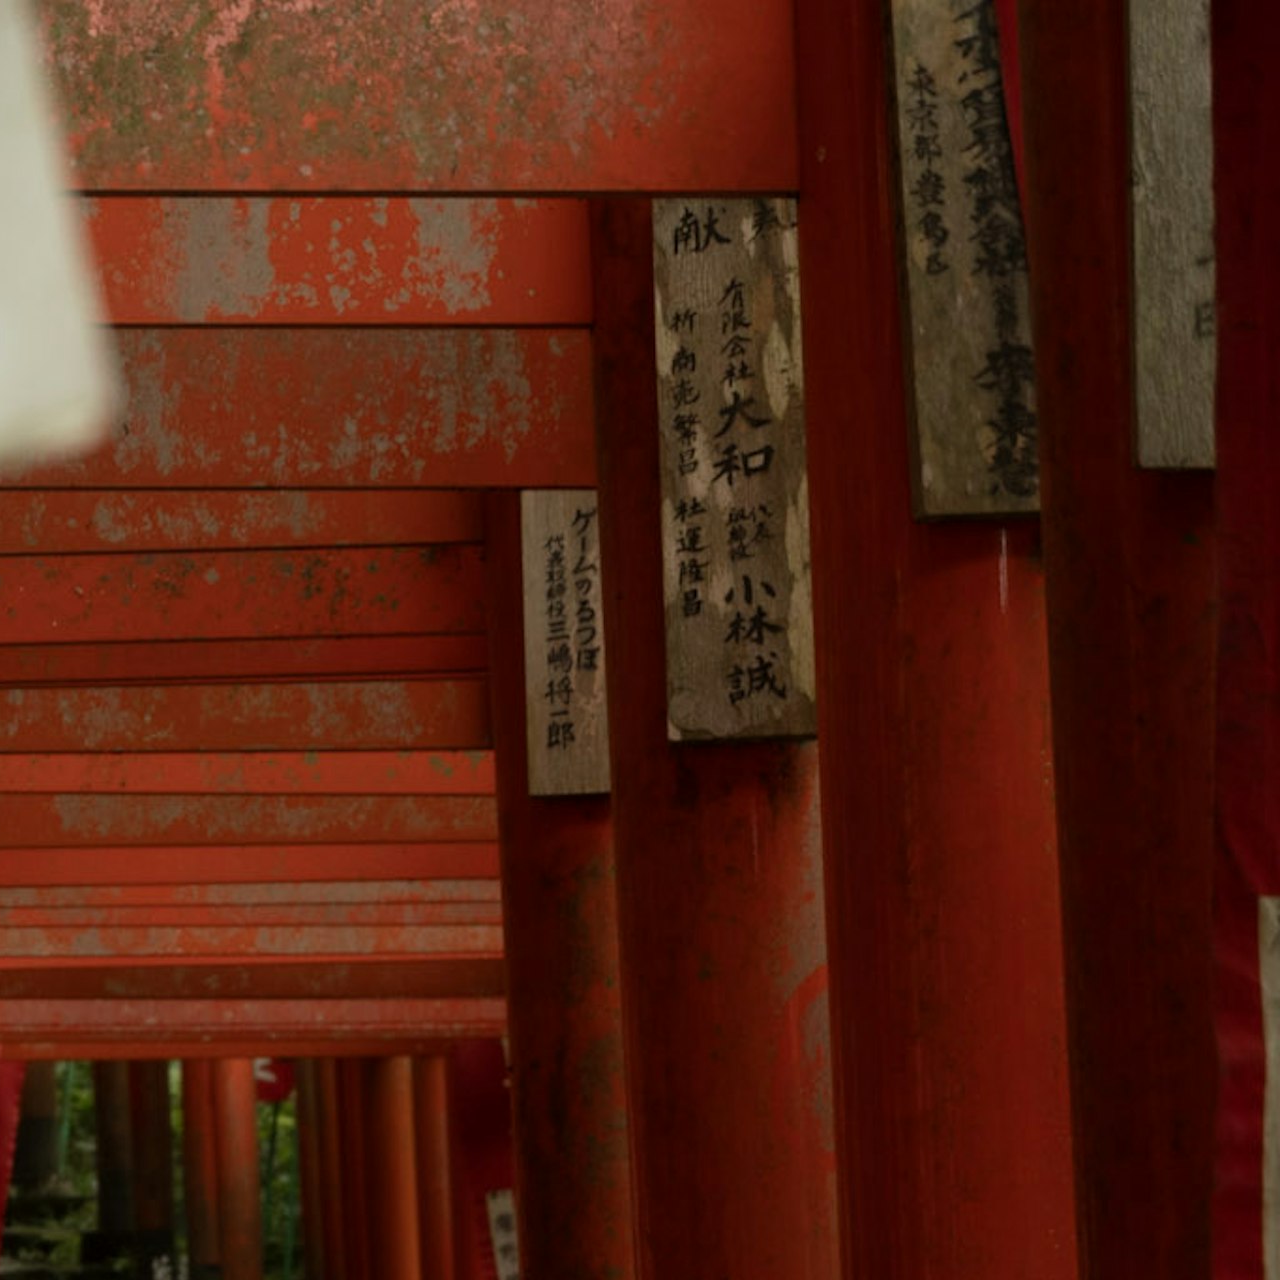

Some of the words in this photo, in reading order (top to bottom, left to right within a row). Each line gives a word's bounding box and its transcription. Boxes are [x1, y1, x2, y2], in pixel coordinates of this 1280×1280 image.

[672, 207, 731, 255] 献
[724, 573, 787, 706] 小林誠
